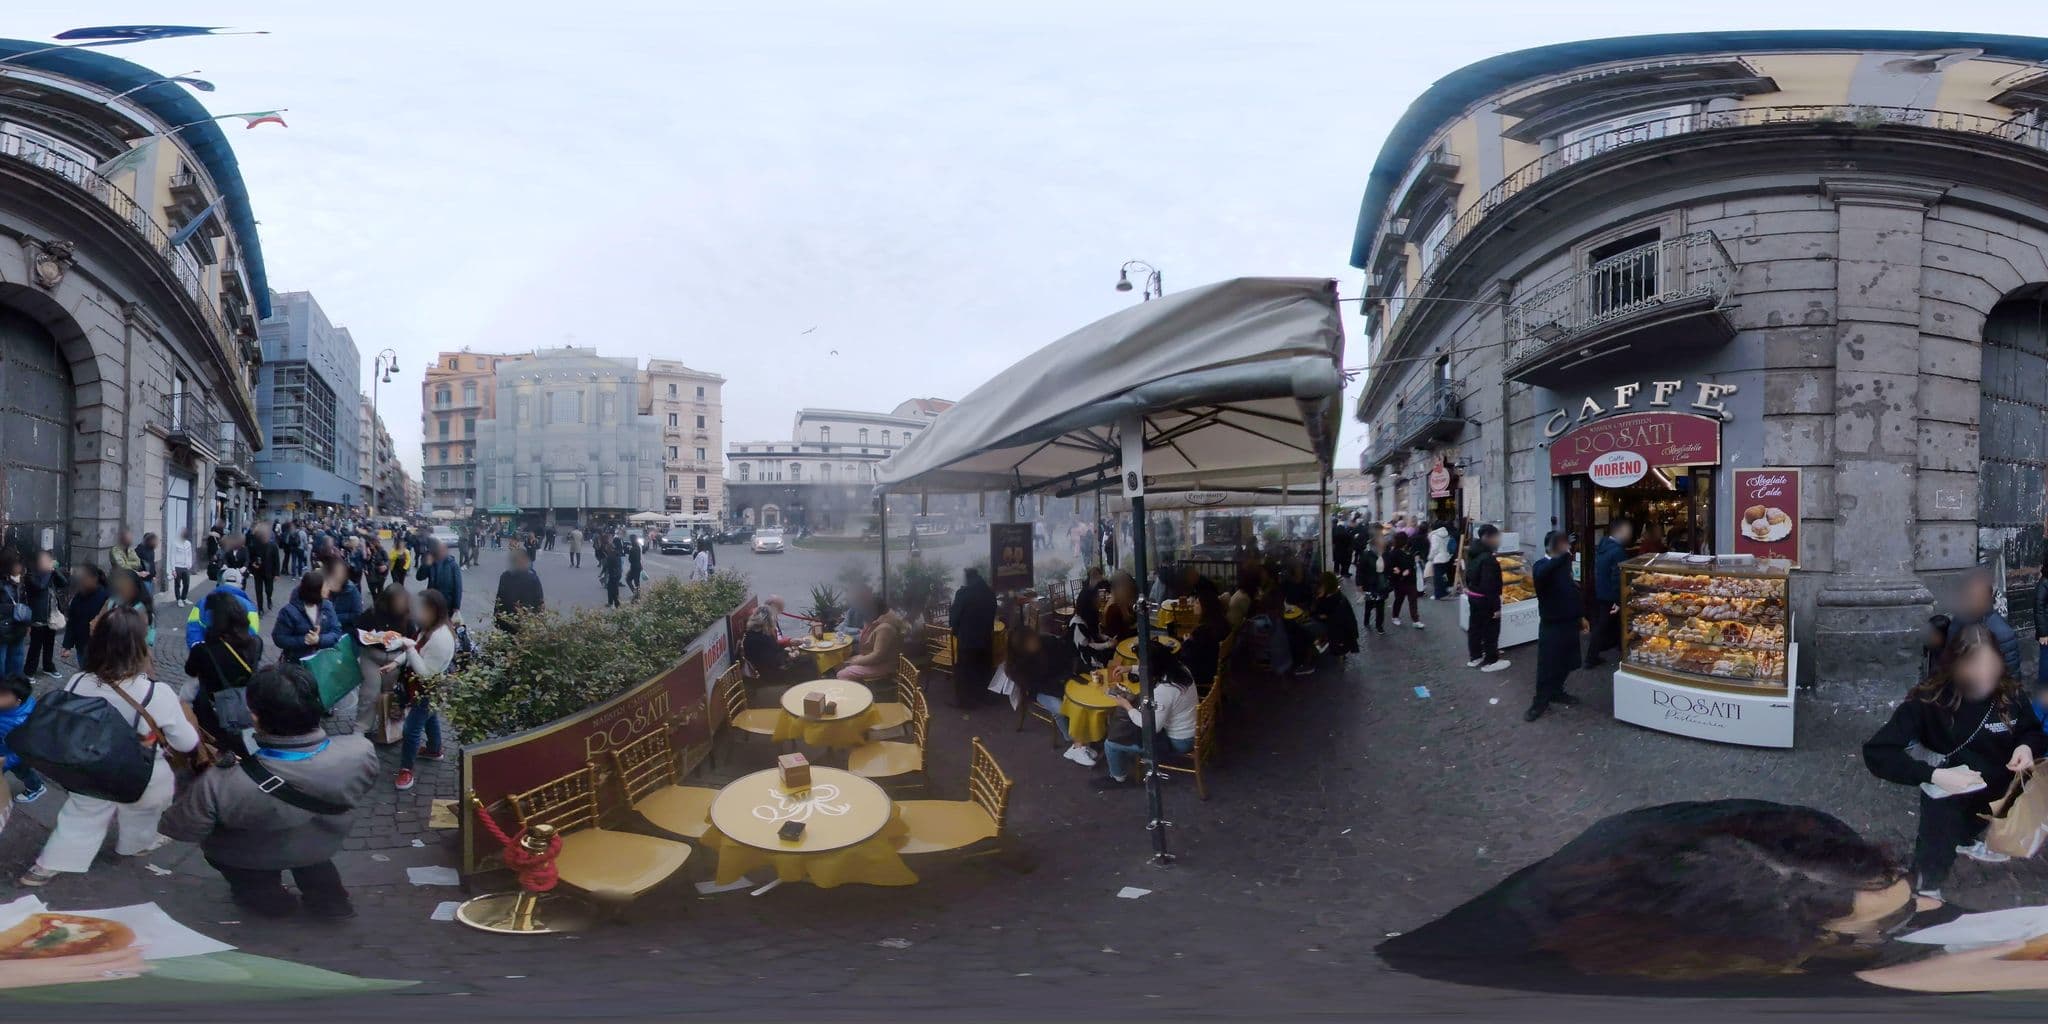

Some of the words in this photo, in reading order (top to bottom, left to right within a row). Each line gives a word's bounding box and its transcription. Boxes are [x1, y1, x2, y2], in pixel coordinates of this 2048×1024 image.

[1575, 423, 1674, 455] ROSATI
[1594, 460, 1641, 476] MORENO
[1746, 474, 1787, 487] Sfogliate
[1751, 486, 1782, 498] Calde
[1653, 690, 1741, 719] ROSATI
[584, 691, 670, 760] ROSATI
